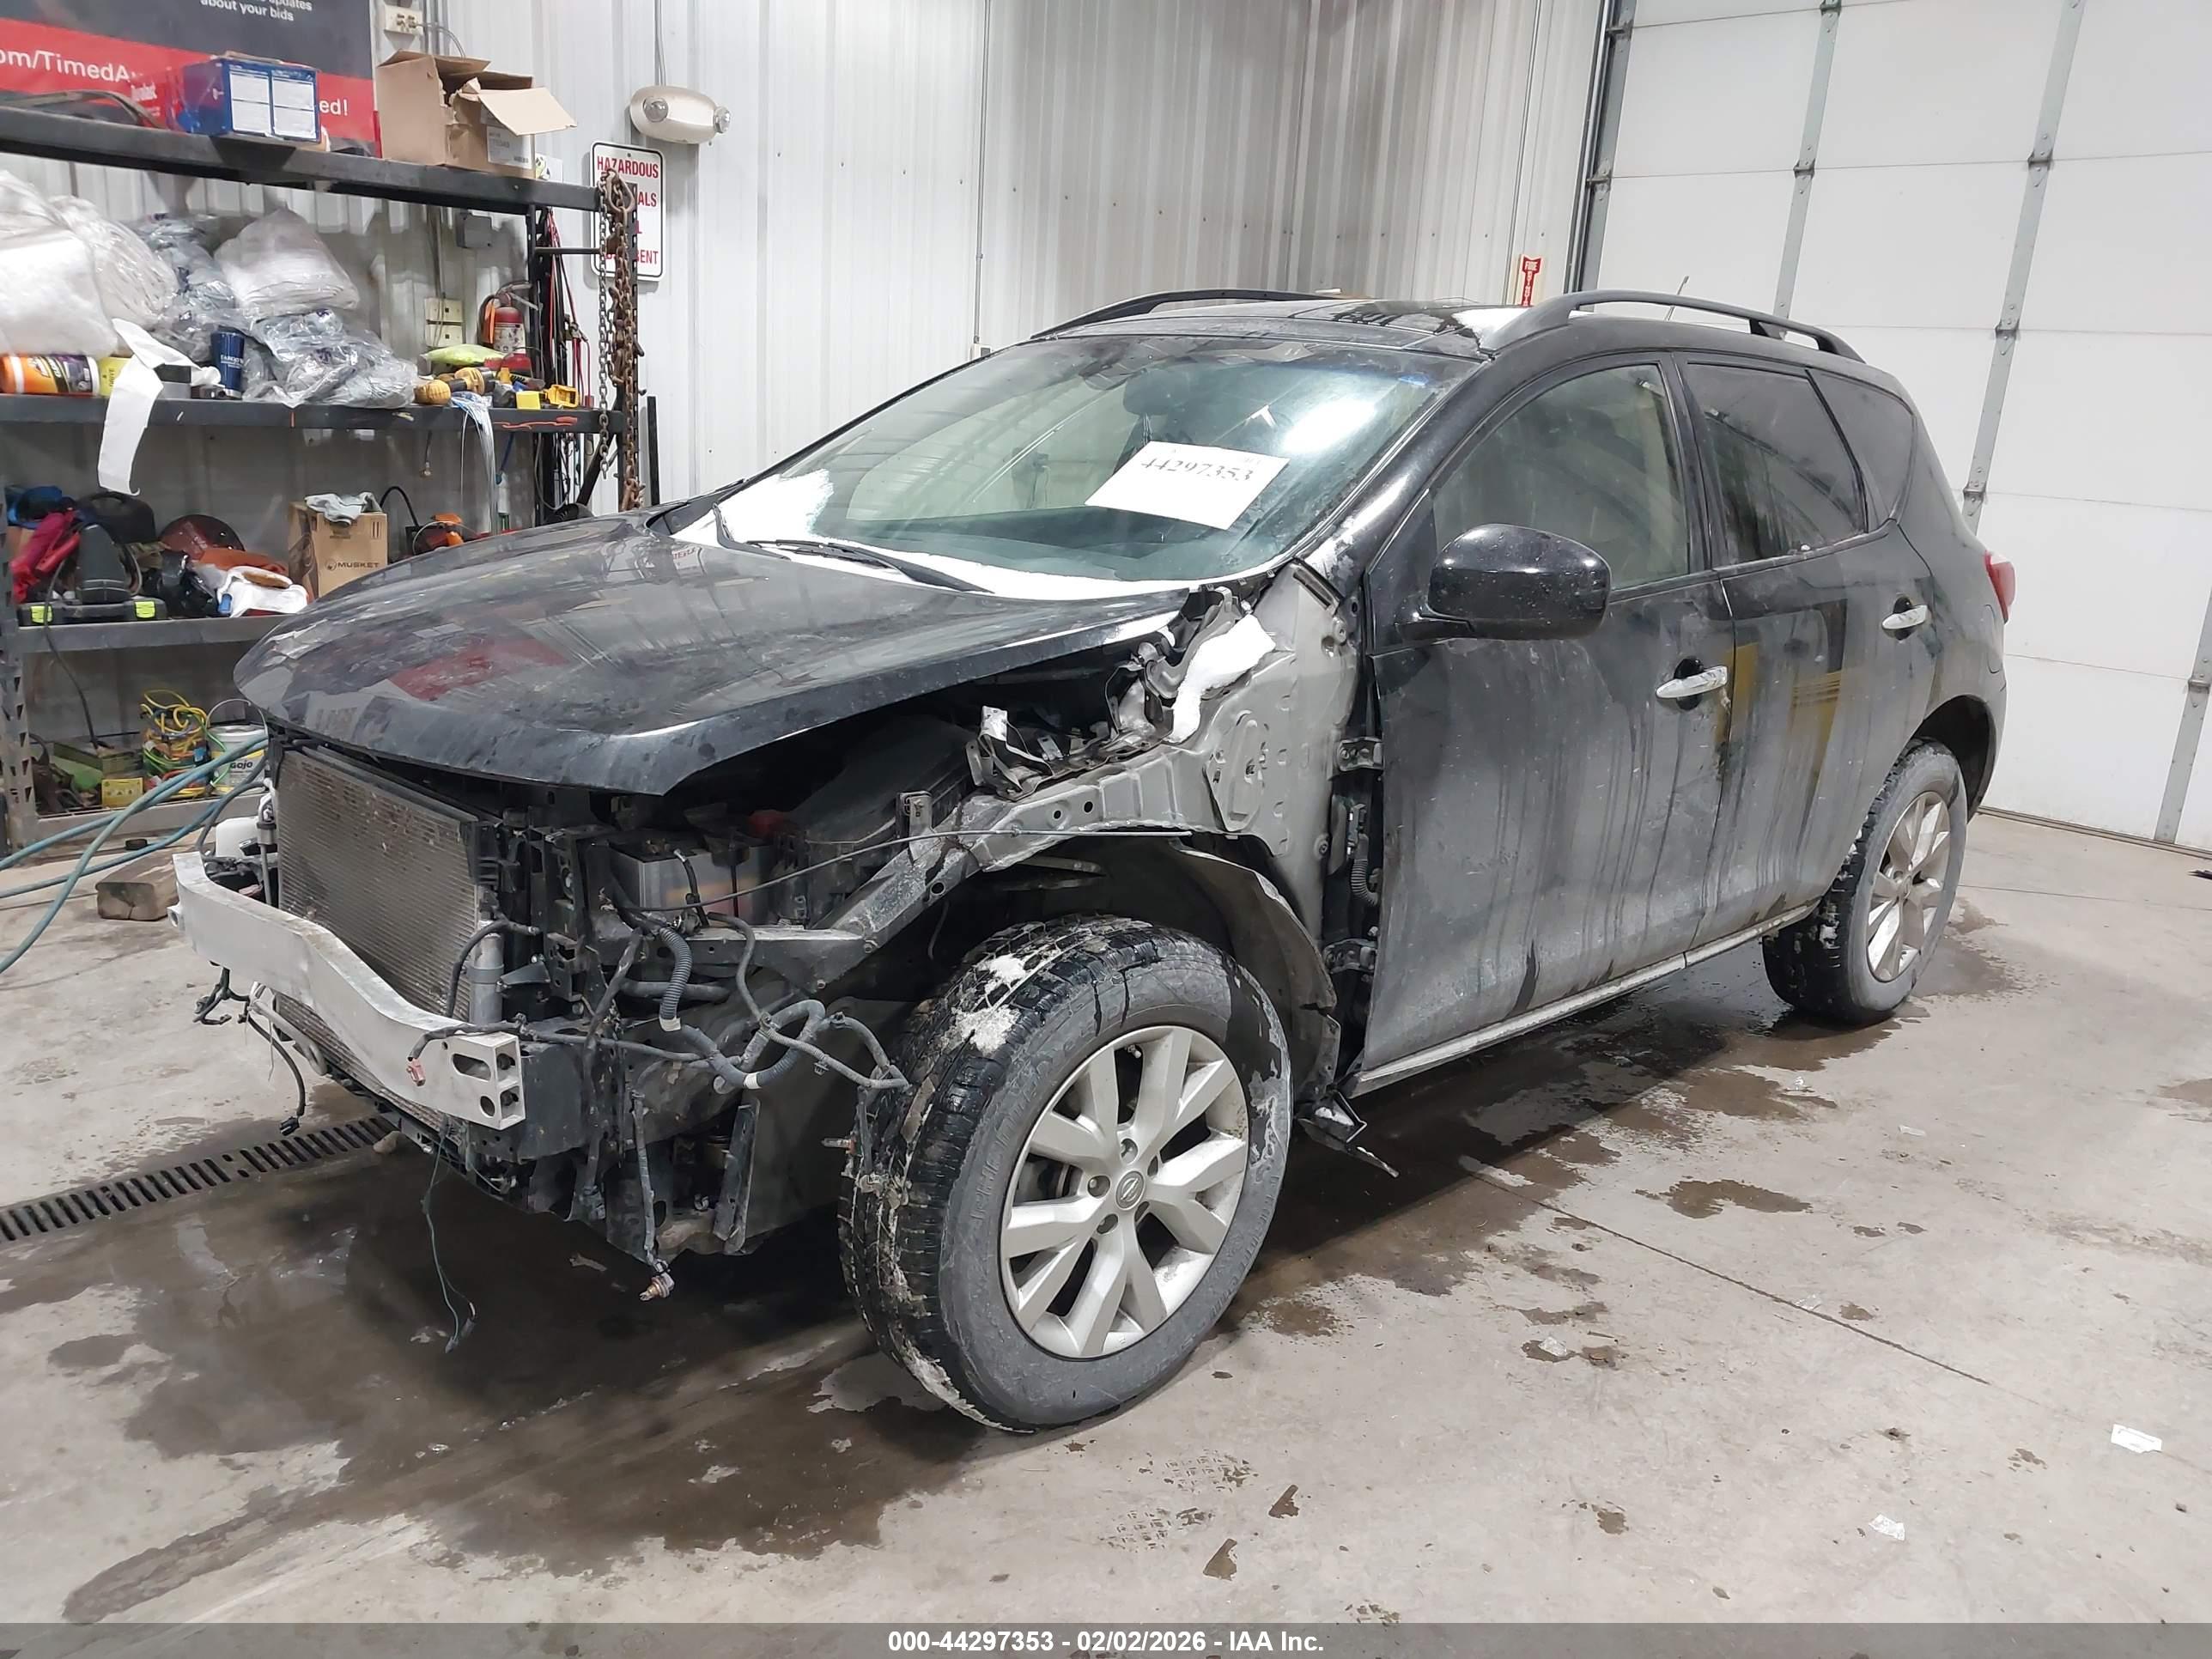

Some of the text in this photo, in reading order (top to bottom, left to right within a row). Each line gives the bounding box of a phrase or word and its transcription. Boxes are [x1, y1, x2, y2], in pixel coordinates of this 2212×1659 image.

[200, 0, 294, 21] about your bids
[0, 49, 137, 83] om/TimedA
[597, 155, 659, 179] HAZARDOUS
[1524, 261, 1538, 271] FIRE
[1141, 458, 1254, 481] 44297353
